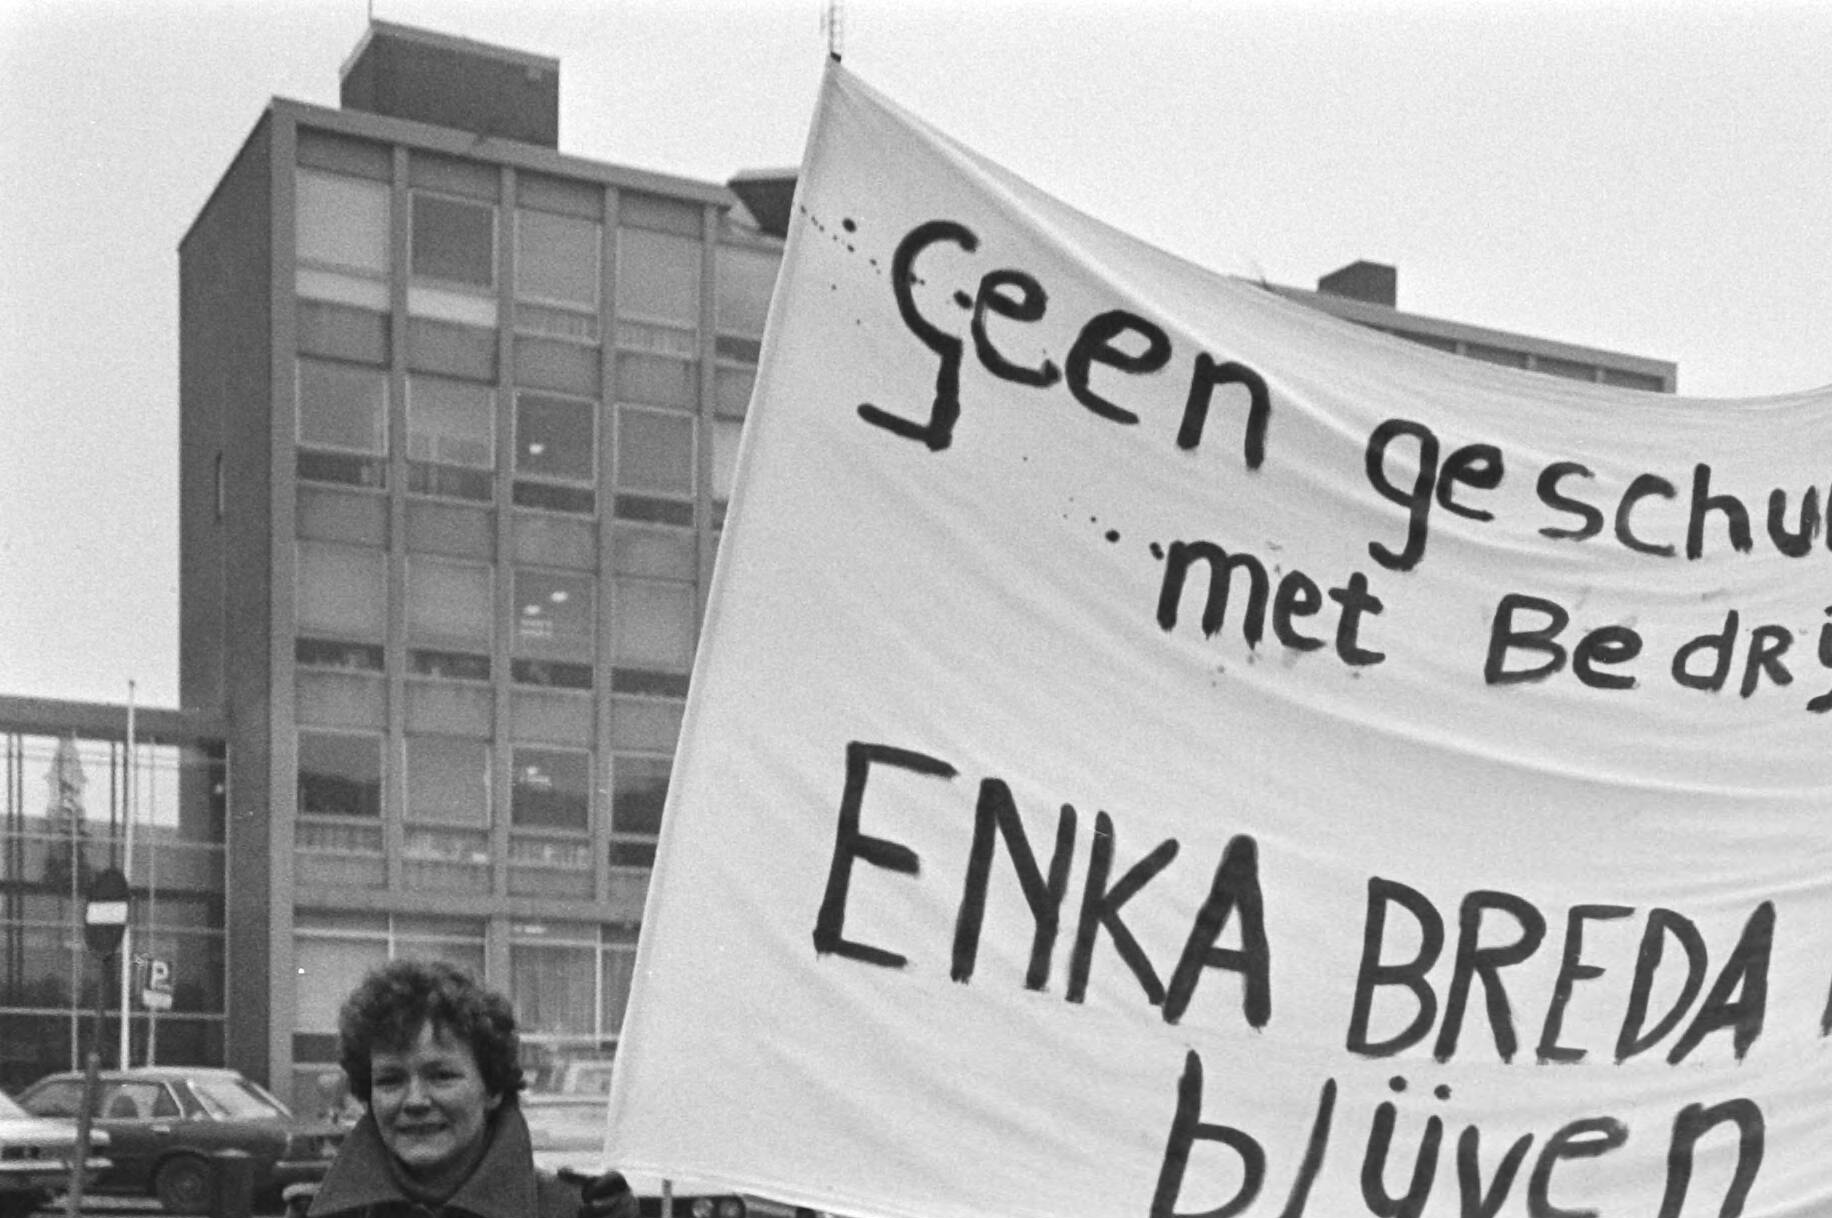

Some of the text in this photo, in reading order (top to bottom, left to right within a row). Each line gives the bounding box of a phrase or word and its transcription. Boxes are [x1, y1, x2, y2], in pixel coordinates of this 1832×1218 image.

[857, 219, 1270, 471] Geen
[1156, 540, 1386, 666] met
[150, 960, 169, 990] P
[812, 740, 1272, 1031] ENKA
[1346, 876, 1777, 1065] BREDA
